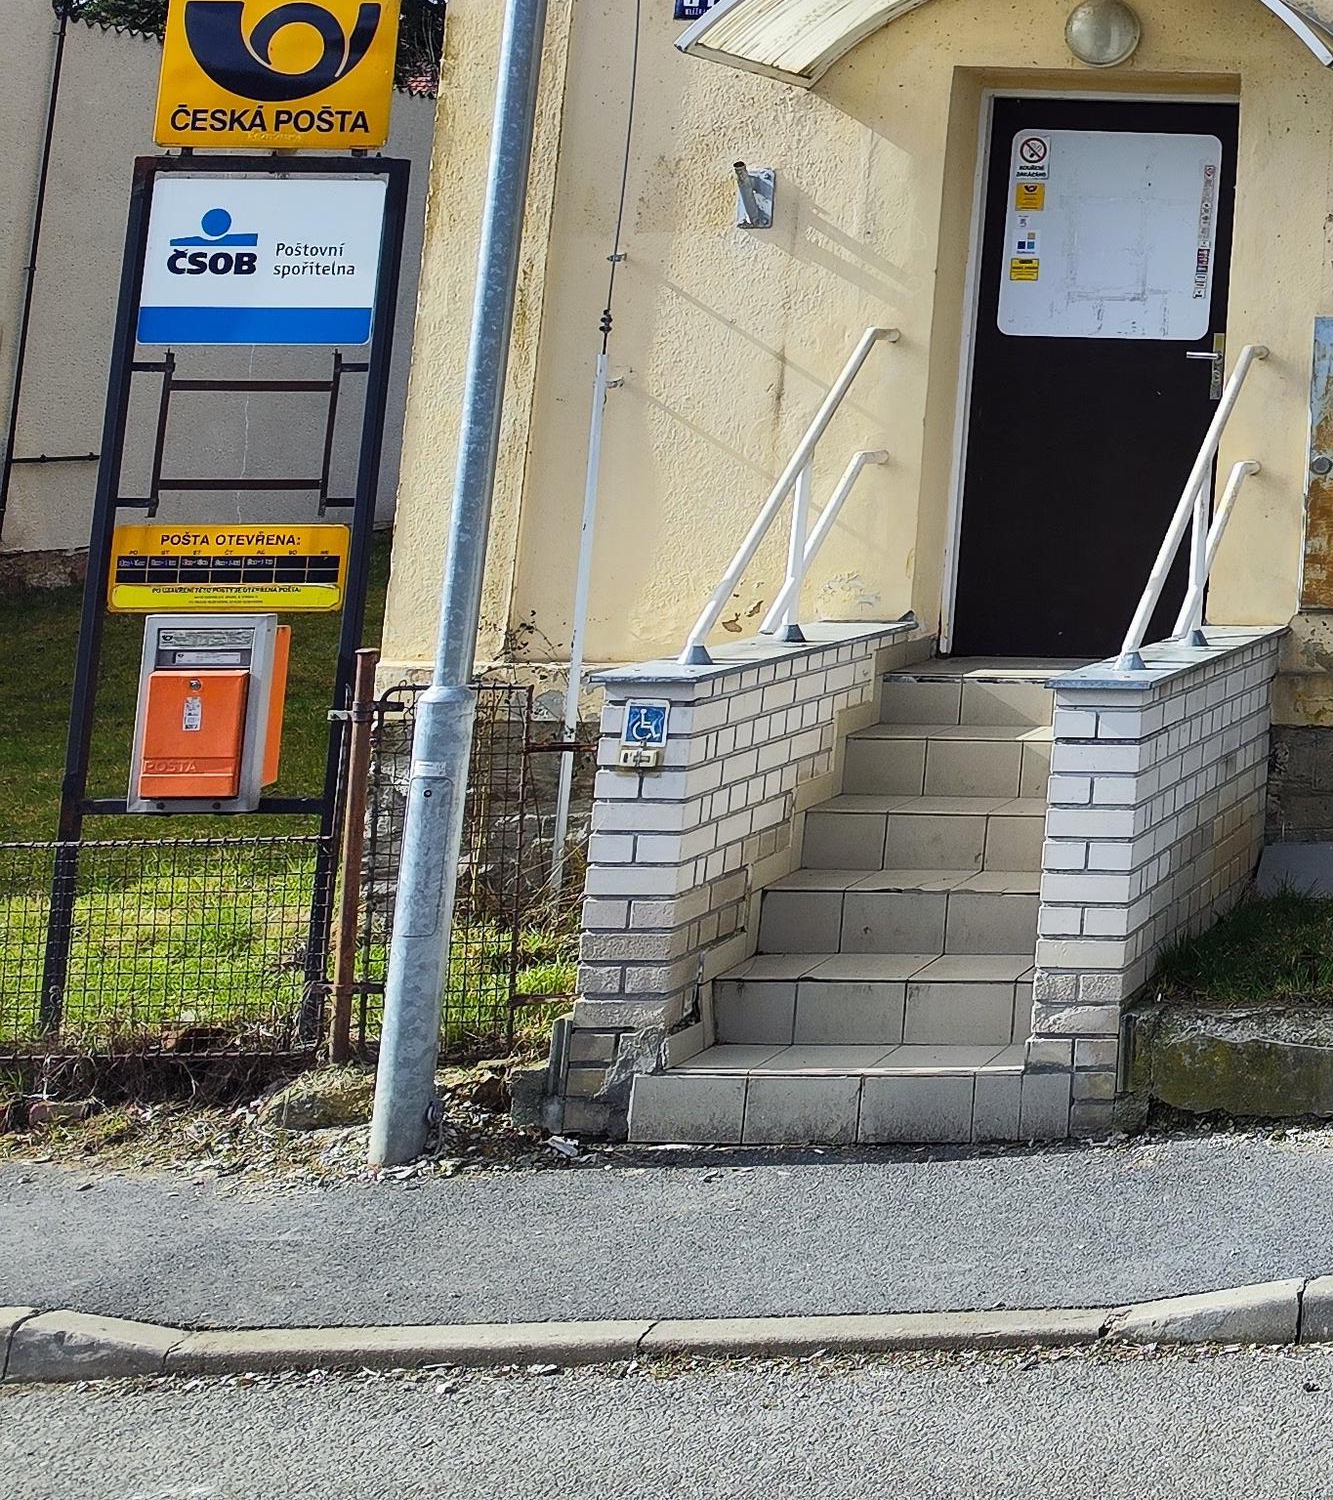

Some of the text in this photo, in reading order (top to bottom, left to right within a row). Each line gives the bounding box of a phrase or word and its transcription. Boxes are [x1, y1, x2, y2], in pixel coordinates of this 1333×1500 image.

[170, 104, 370, 133] ČESKÁ POŠTA
[275, 242, 346, 257] Poštovní
[167, 249, 257, 275] ČSOB
[273, 261, 355, 278] spořitelna
[161, 531, 301, 546] POŠTA OTEVŘENA:
